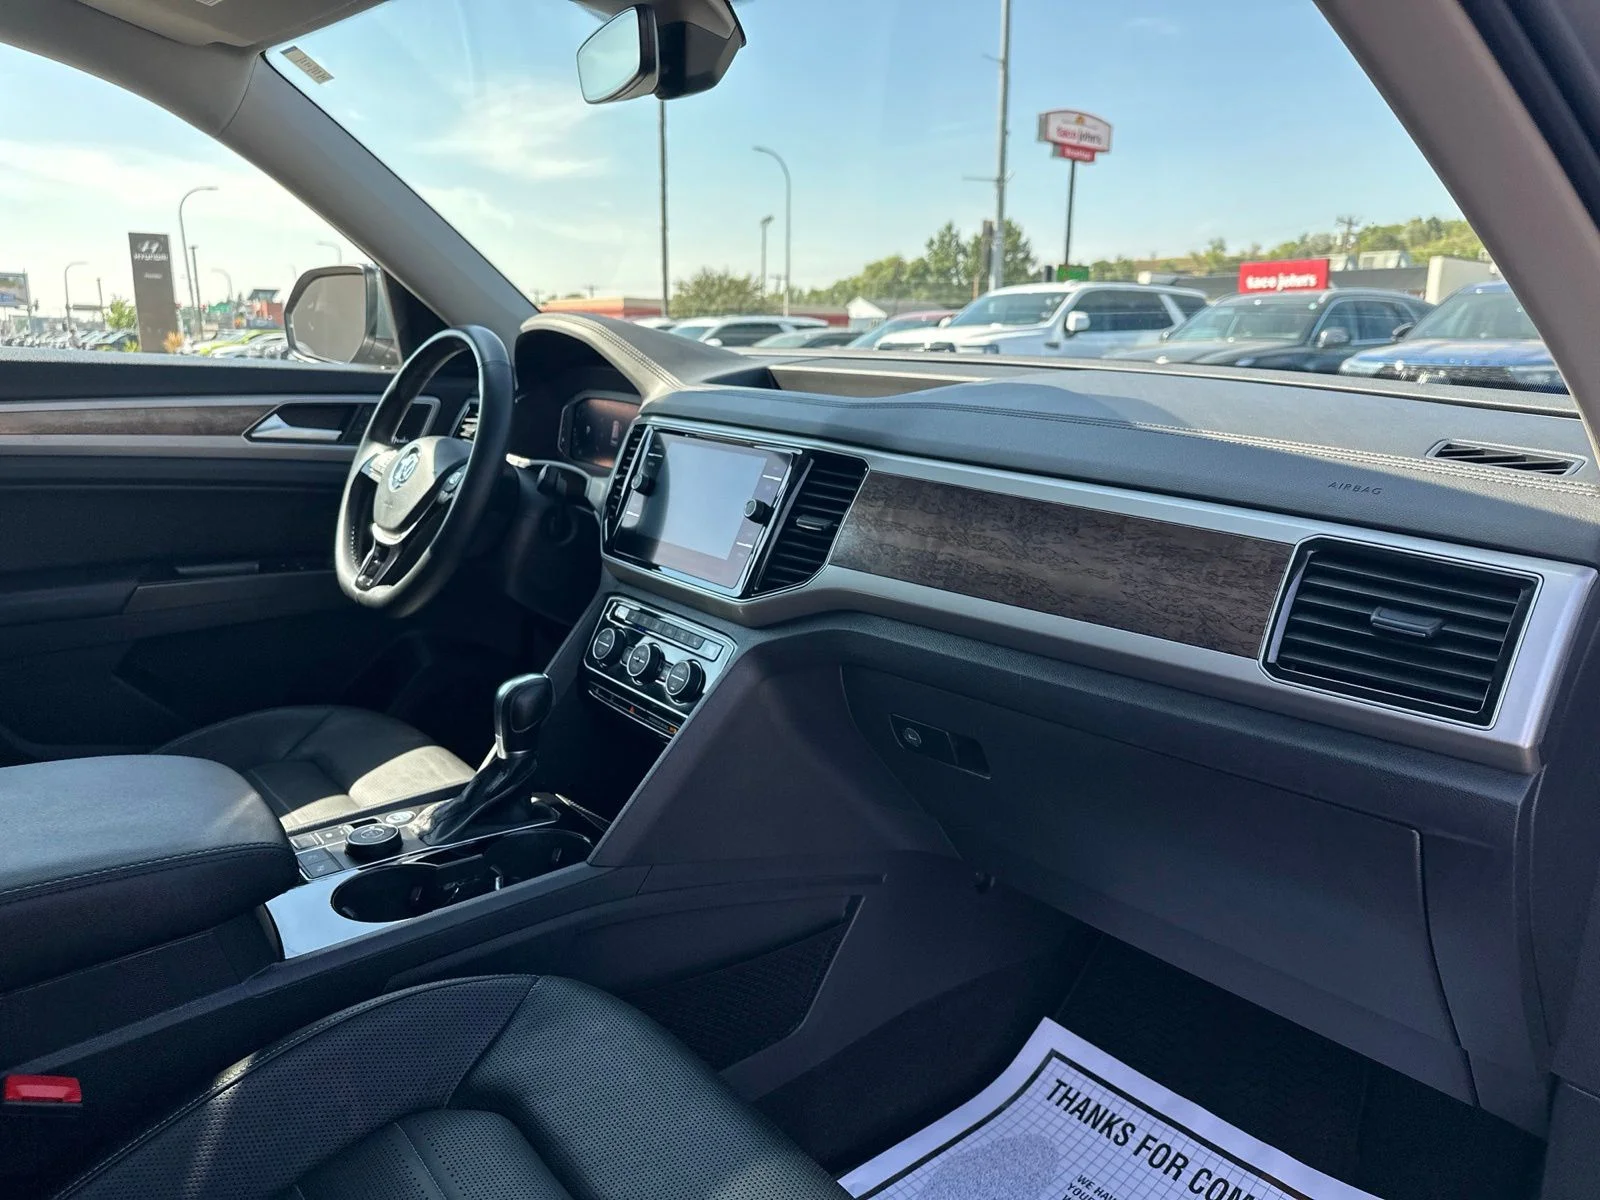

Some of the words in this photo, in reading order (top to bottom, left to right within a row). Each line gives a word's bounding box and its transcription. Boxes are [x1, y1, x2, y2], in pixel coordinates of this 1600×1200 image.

[1328, 481, 1382, 495] AIRBAG
[1046, 1078, 1137, 1147] THANKS
[1133, 1134, 1189, 1181] FOR
[1077, 1174, 1096, 1190] WE
